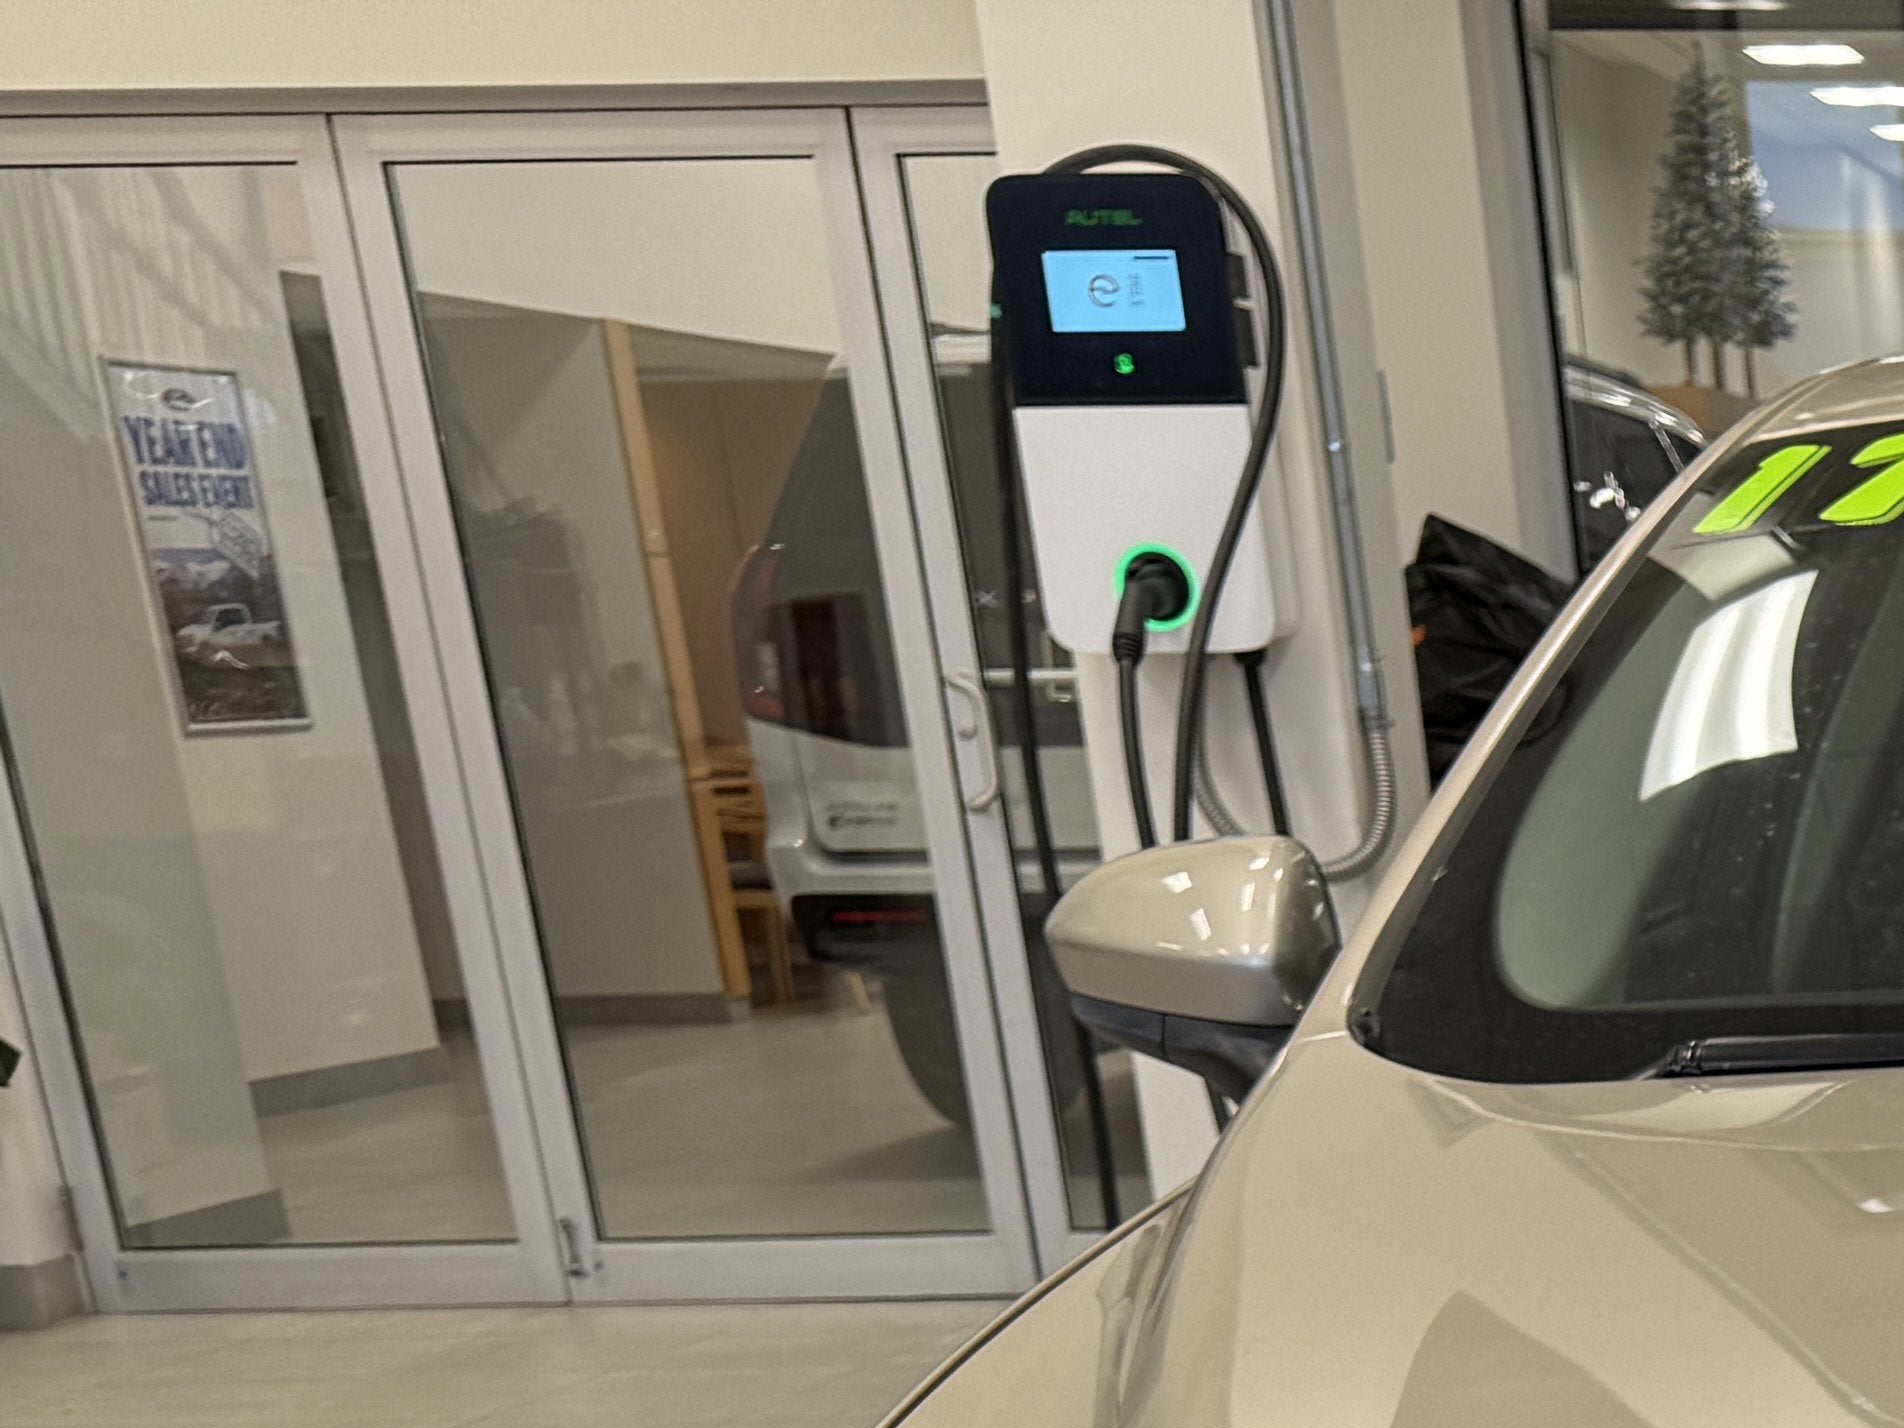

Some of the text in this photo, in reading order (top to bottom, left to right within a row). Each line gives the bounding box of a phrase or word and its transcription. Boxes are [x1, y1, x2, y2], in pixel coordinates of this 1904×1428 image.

[1065, 208, 1143, 226] AUTEL
[123, 415, 249, 471] YEAR END
[139, 470, 254, 510] SALES EVENT
